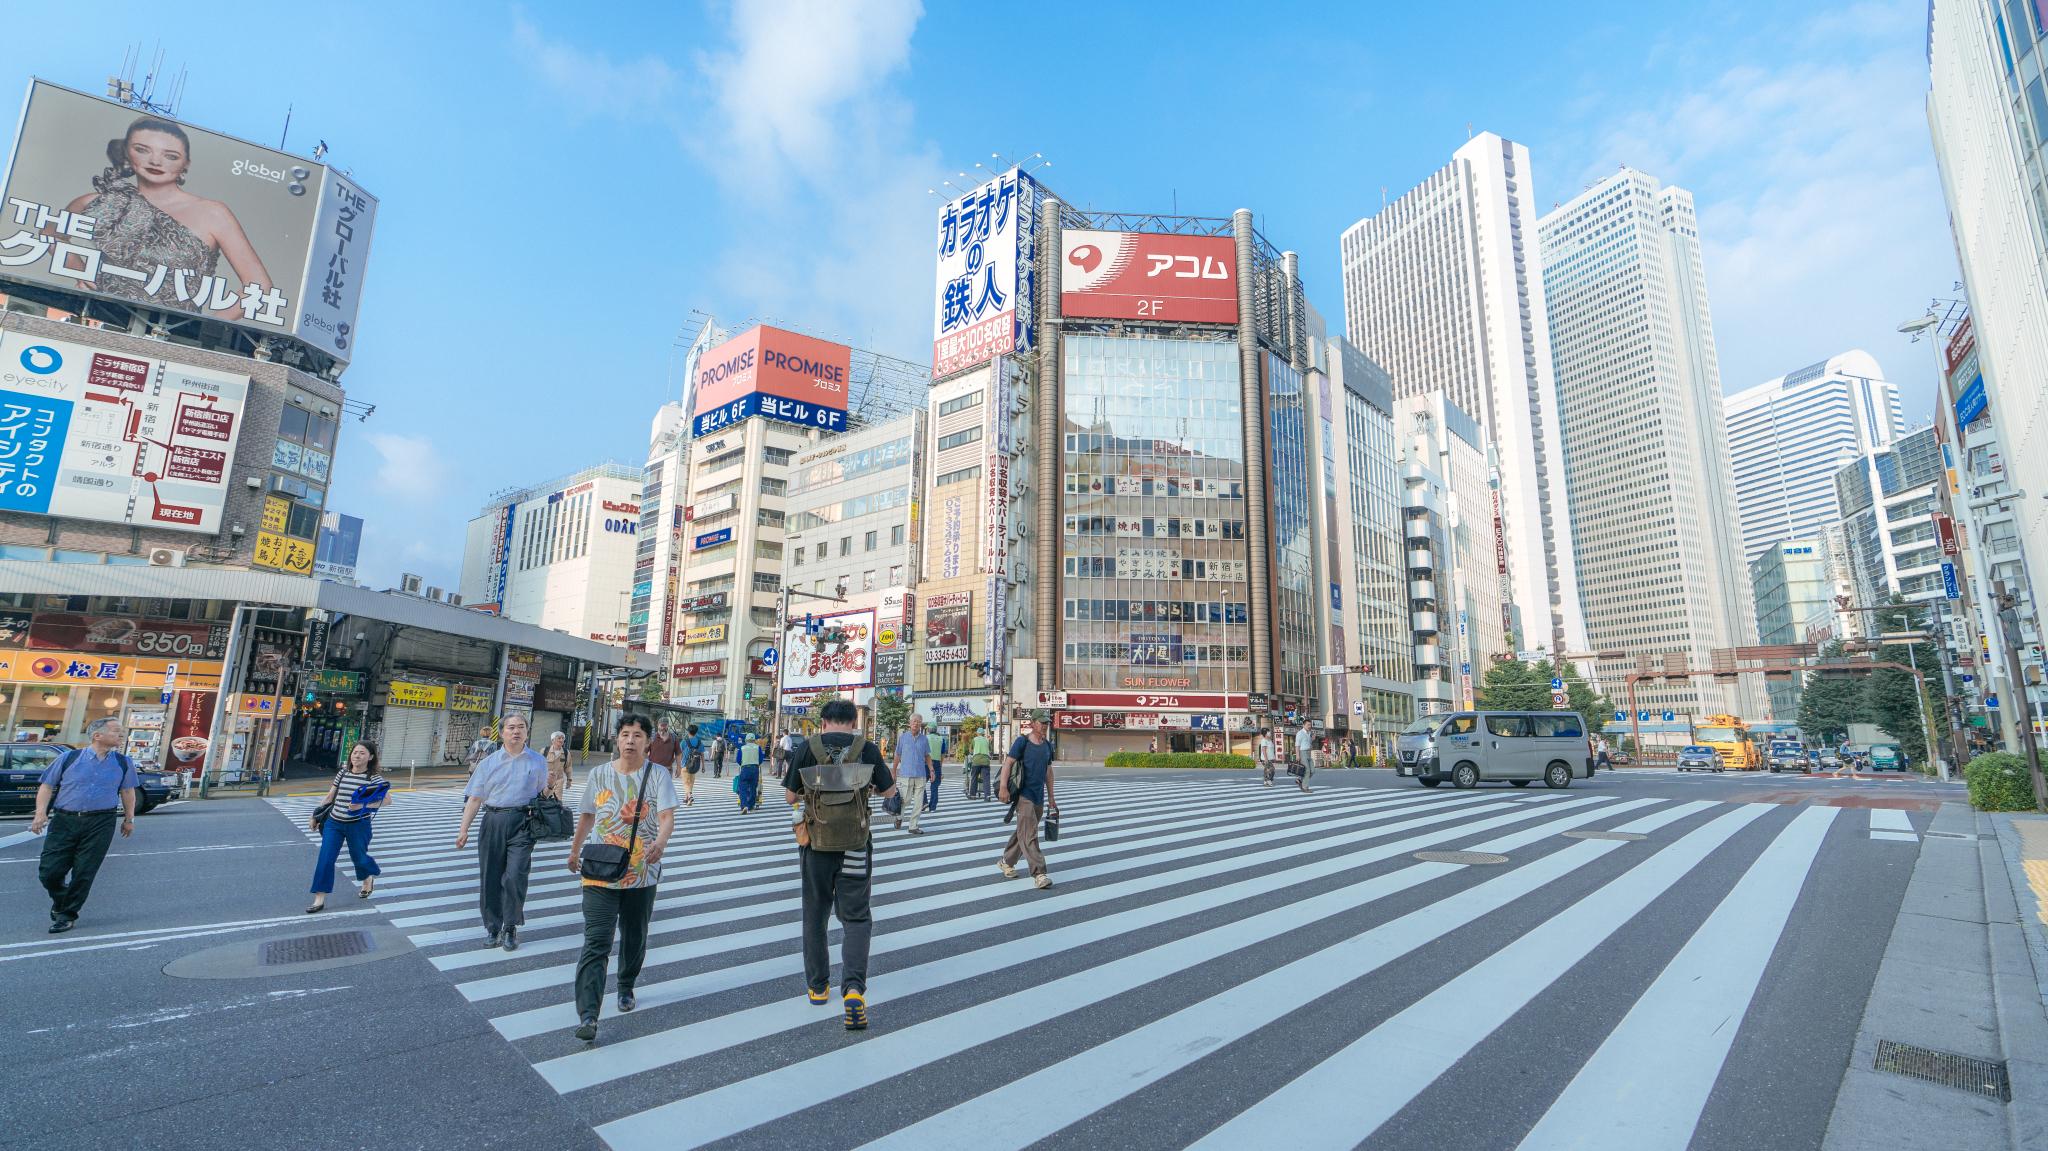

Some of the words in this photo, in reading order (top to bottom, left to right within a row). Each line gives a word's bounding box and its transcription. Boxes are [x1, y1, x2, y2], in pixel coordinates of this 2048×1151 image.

[231, 159, 286, 181] global
[336, 182, 366, 213] THE
[8, 197, 97, 240] THE
[940, 176, 1016, 261] カラオケ
[322, 205, 358, 310] グローバル社
[965, 240, 984, 276] の
[1015, 175, 1035, 355] カラオケの鉄人
[1147, 254, 1229, 280] アコム
[0, 230, 288, 326] グローバル社
[941, 261, 1007, 334] 鉄人
[1137, 300, 1164, 316] 2F
[303, 313, 336, 334] global
[95, 357, 147, 375] ミラザ新宿店
[701, 348, 754, 389] PROMISE
[765, 350, 843, 383] PROMISE
[3, 373, 69, 393] eyecity
[182, 378, 220, 392] 甲州街道
[732, 371, 752, 387] プロミス
[813, 378, 841, 393] プロミス
[761, 396, 809, 419] 当ビル
[816, 409, 840, 427] 6F
[991, 357, 999, 449] カラオケの鉄人
[1000, 356, 1009, 452] カラオケの鉄人
[141, 402, 159, 436] 新宿駅
[184, 407, 230, 424] 新宿南口店
[701, 410, 728, 432] 当ビル
[731, 399, 746, 418] 6F
[16, 409, 55, 497] コンタクトの
[80, 439, 122, 452] 新宿通り
[174, 446, 224, 461] ルミネエスト
[91, 459, 116, 468] アルタ
[172, 455, 200, 467] 新宿店
[71, 475, 114, 488] 靖国通り
[1014, 363, 1032, 629] カラオケの鉄人
[159, 507, 195, 521] 現在地
[602, 500, 641, 515] ビックカ
[987, 455, 997, 575] 100名収容大パーティールーム
[996, 454, 1009, 576] 100名収容大パーティールーム
[605, 518, 640, 535] ODAK
[1117, 521, 1141, 532] 焼肉
[700, 533, 719, 546] PROMISE
[952, 498, 961, 577] ご予約承ります
[1944, 538, 1955, 552] ibis
[269, 537, 282, 566] おでん
[329, 564, 353, 576] 新宿駅
[1130, 568, 1168, 580] すみれ
[1209, 561, 1231, 572] 新宿
[884, 597, 893, 605] SS
[665, 600, 674, 622] カラオケ
[881, 633, 894, 642] ZOO
[1806, 623, 1833, 643] Paloma
[137, 632, 204, 656] 350円
[808, 648, 868, 678] まねきねこ
[878, 656, 904, 665] ビリヤード
[925, 647, 968, 662] 03-3345-6430
[1131, 644, 1170, 664] 大戸屋
[64, 660, 120, 679] 松屋
[167, 666, 174, 680] P
[676, 666, 694, 675] カラオケ
[887, 663, 904, 673] ダーツ
[1124, 677, 1145, 687] SUN
[1148, 678, 1191, 687] FLOWER
[453, 694, 476, 707] チケット
[696, 699, 715, 707] カラオケ
[794, 694, 812, 704] カラオケ
[1148, 696, 1179, 707] アコム
[930, 699, 977, 718] カラオケの鉄人
[1061, 715, 1090, 726] 宝くじ
